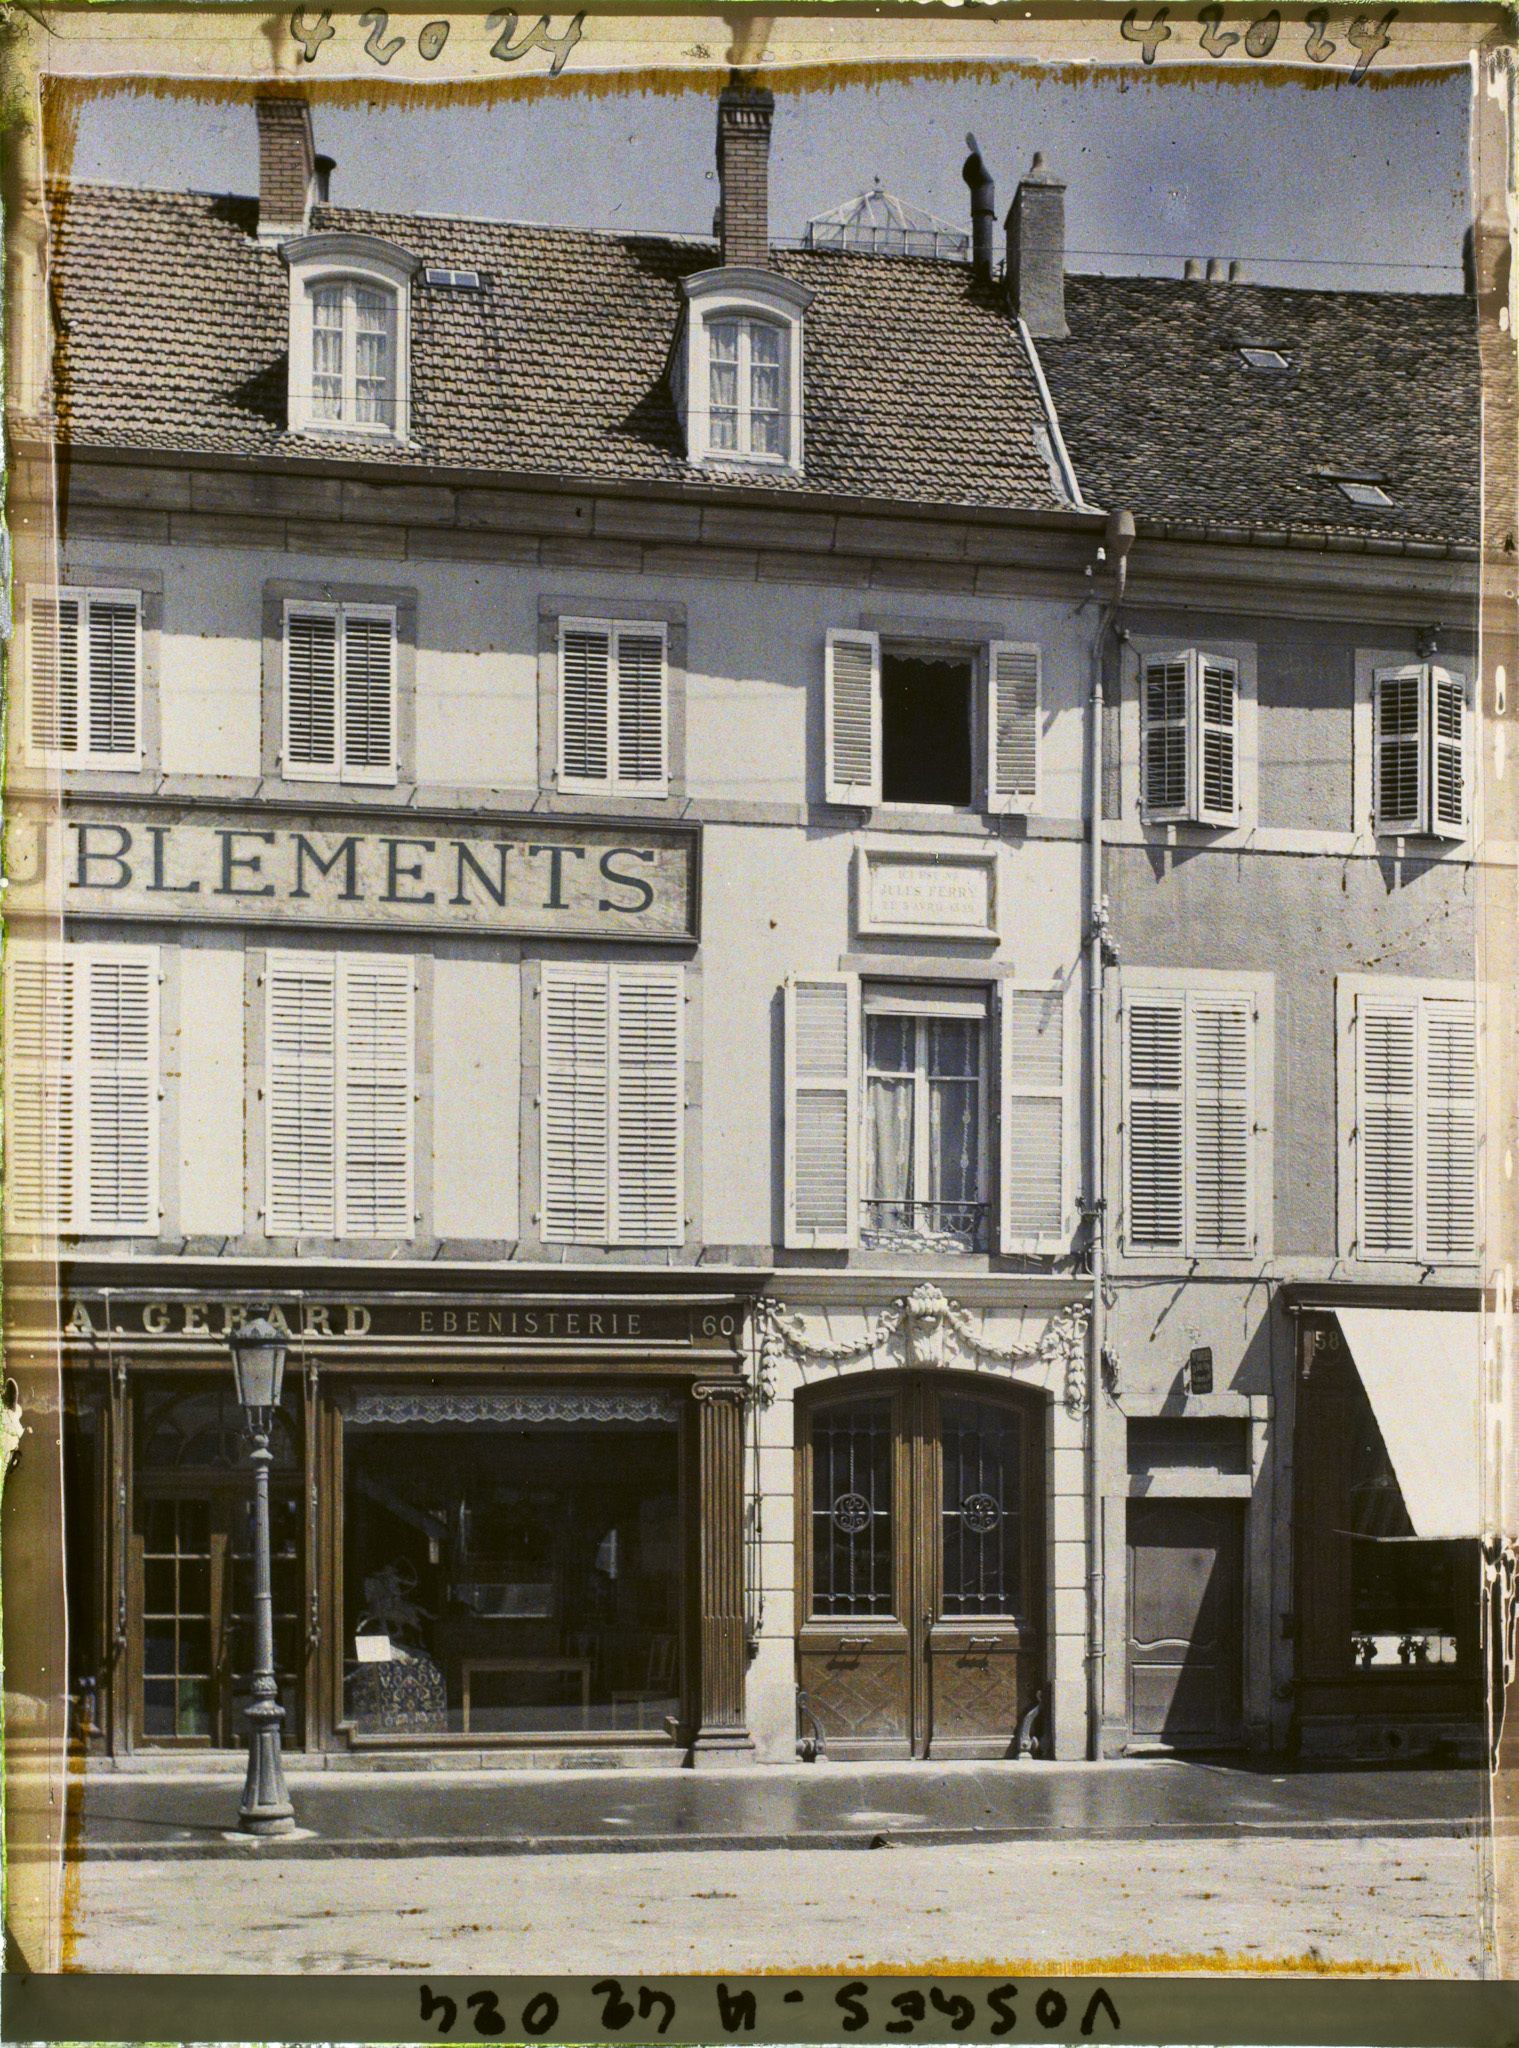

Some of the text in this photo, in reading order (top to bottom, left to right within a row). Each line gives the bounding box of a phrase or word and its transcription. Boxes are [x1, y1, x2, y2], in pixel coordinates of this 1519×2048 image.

[928, 885, 976, 899] FERRY
[141, 1302, 372, 1337] GERARD
[420, 1311, 642, 1336] EBENISTERIE
[701, 1314, 736, 1338] 60
[1314, 1330, 1340, 1351] 58
